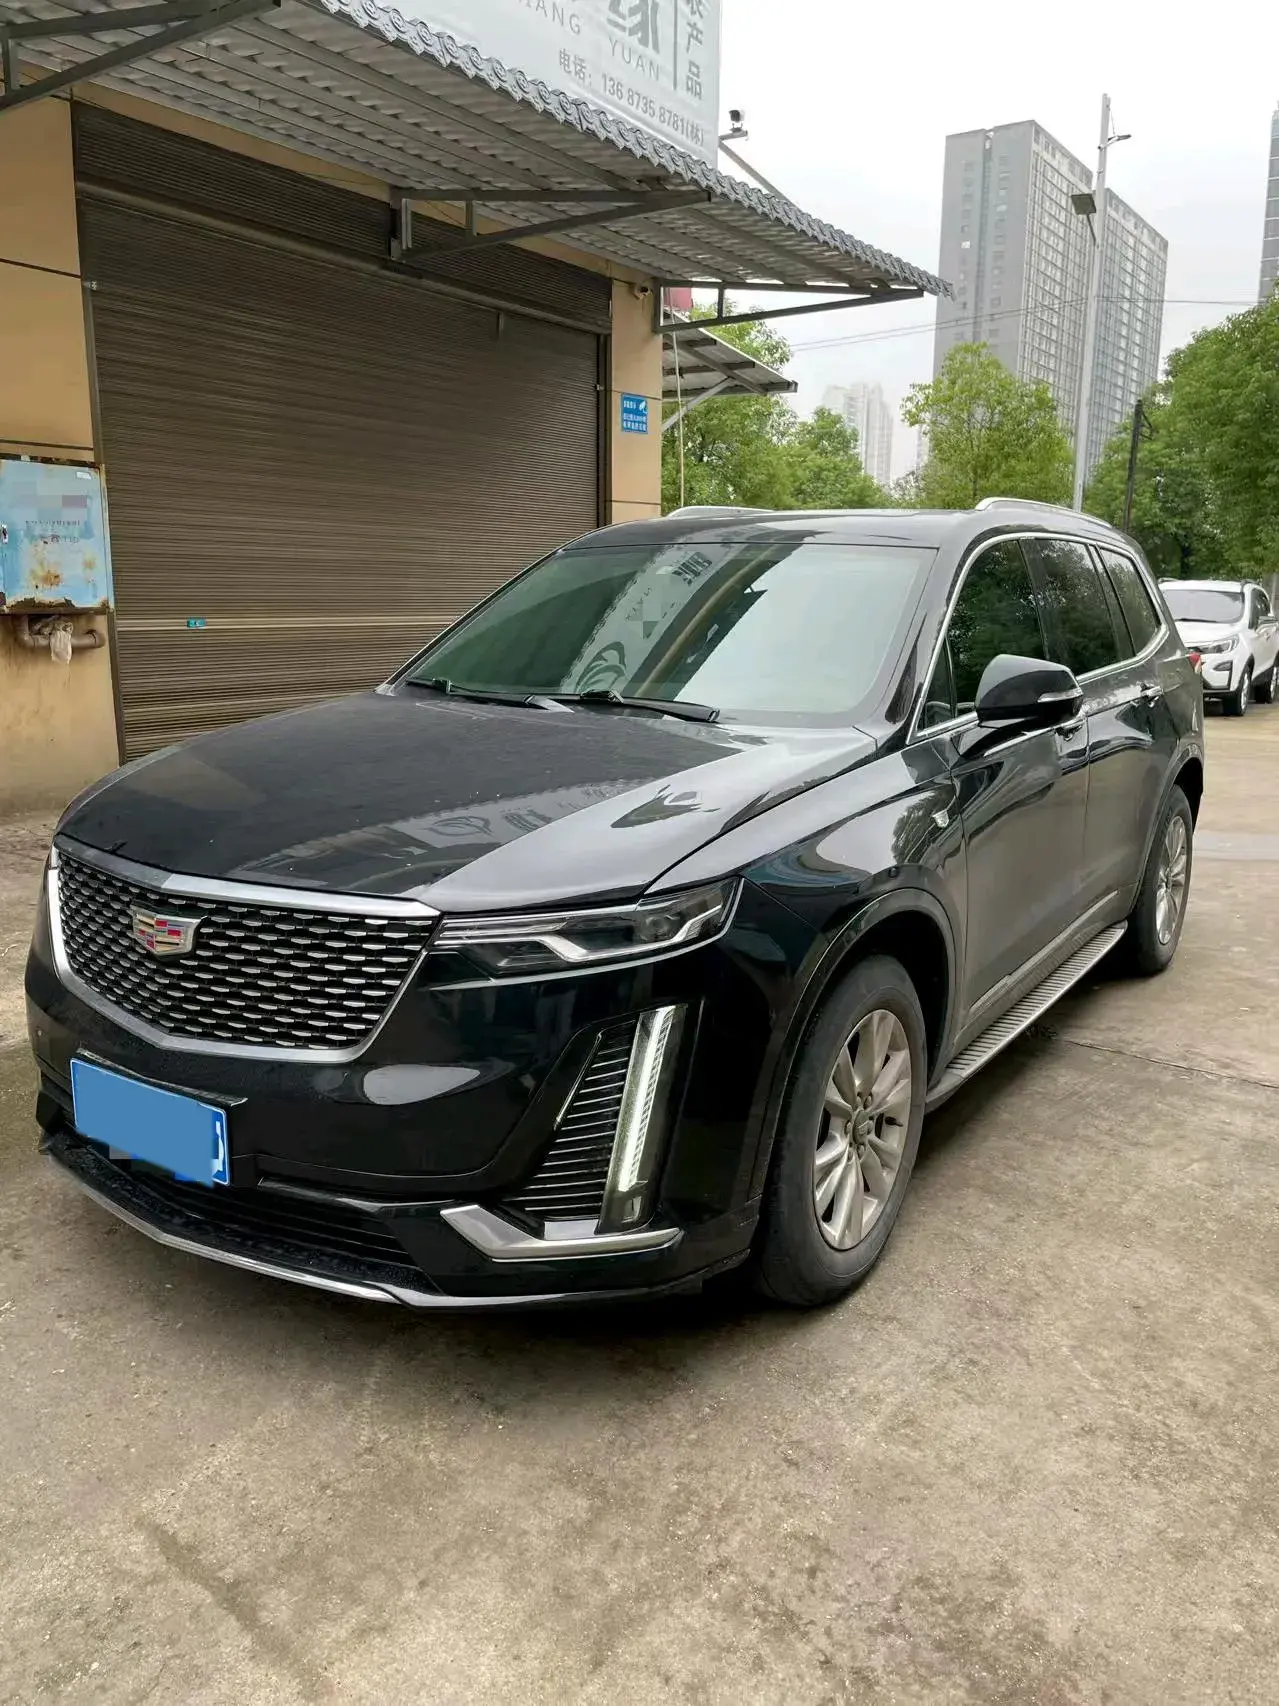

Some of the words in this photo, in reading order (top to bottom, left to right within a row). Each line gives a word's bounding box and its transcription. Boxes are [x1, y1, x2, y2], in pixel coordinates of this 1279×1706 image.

[608, 34, 660, 81] YUAN
[602, 72, 623, 101] 136
[627, 87, 656, 118] 8735
